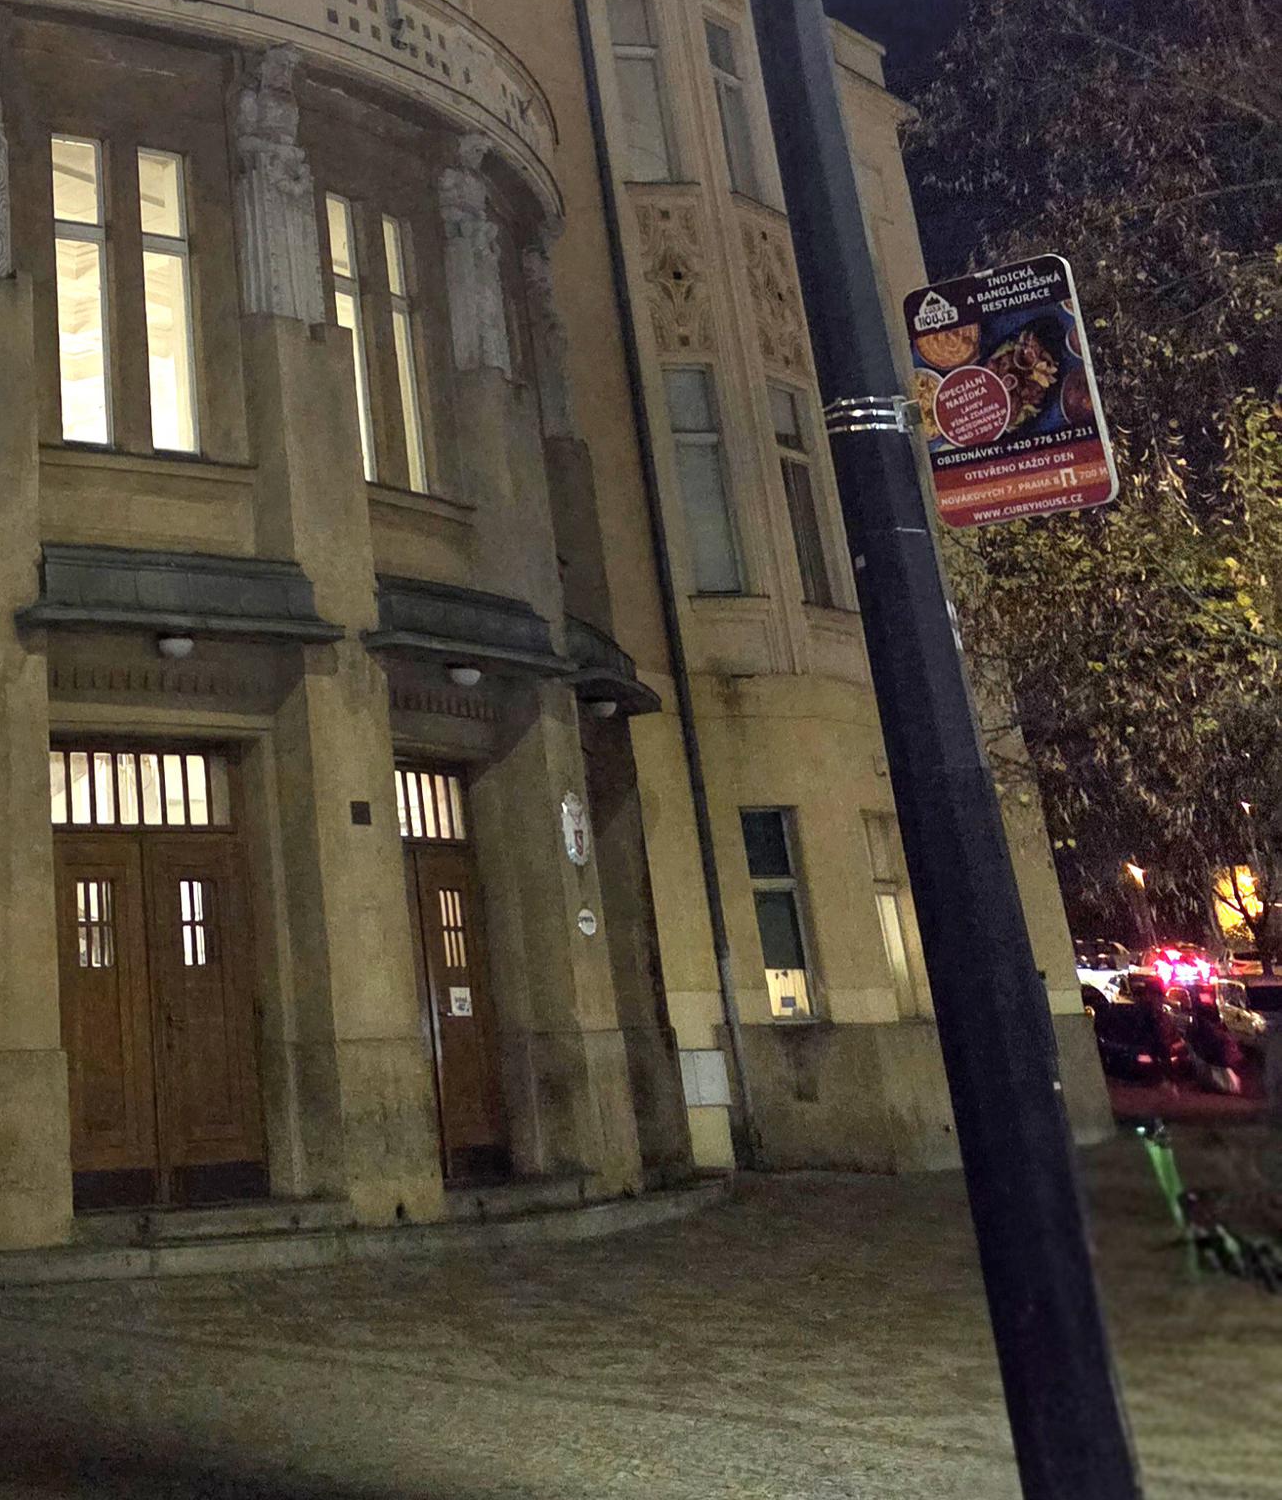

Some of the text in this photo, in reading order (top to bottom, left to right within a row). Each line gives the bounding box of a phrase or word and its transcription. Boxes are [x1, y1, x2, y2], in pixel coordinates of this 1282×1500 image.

[966, 271, 1062, 305] A BANGLADÉŠSKÁ
[987, 265, 1035, 287] INDICKÁ
[982, 287, 1051, 313] RESTAURACE
[918, 309, 957, 328] HOUSE
[938, 372, 986, 401] SPECIÁLNÍ
[945, 386, 988, 410] NABÍDKA
[937, 426, 1094, 467] OBJEDNÁVKY: +420 776 157 211
[964, 452, 1075, 481] OTEVŘENO KAŽDÝ DEN
[1018, 479, 1052, 493] PRAHA
[973, 493, 1085, 521] WWW.CURRYHOUSE.CZ
